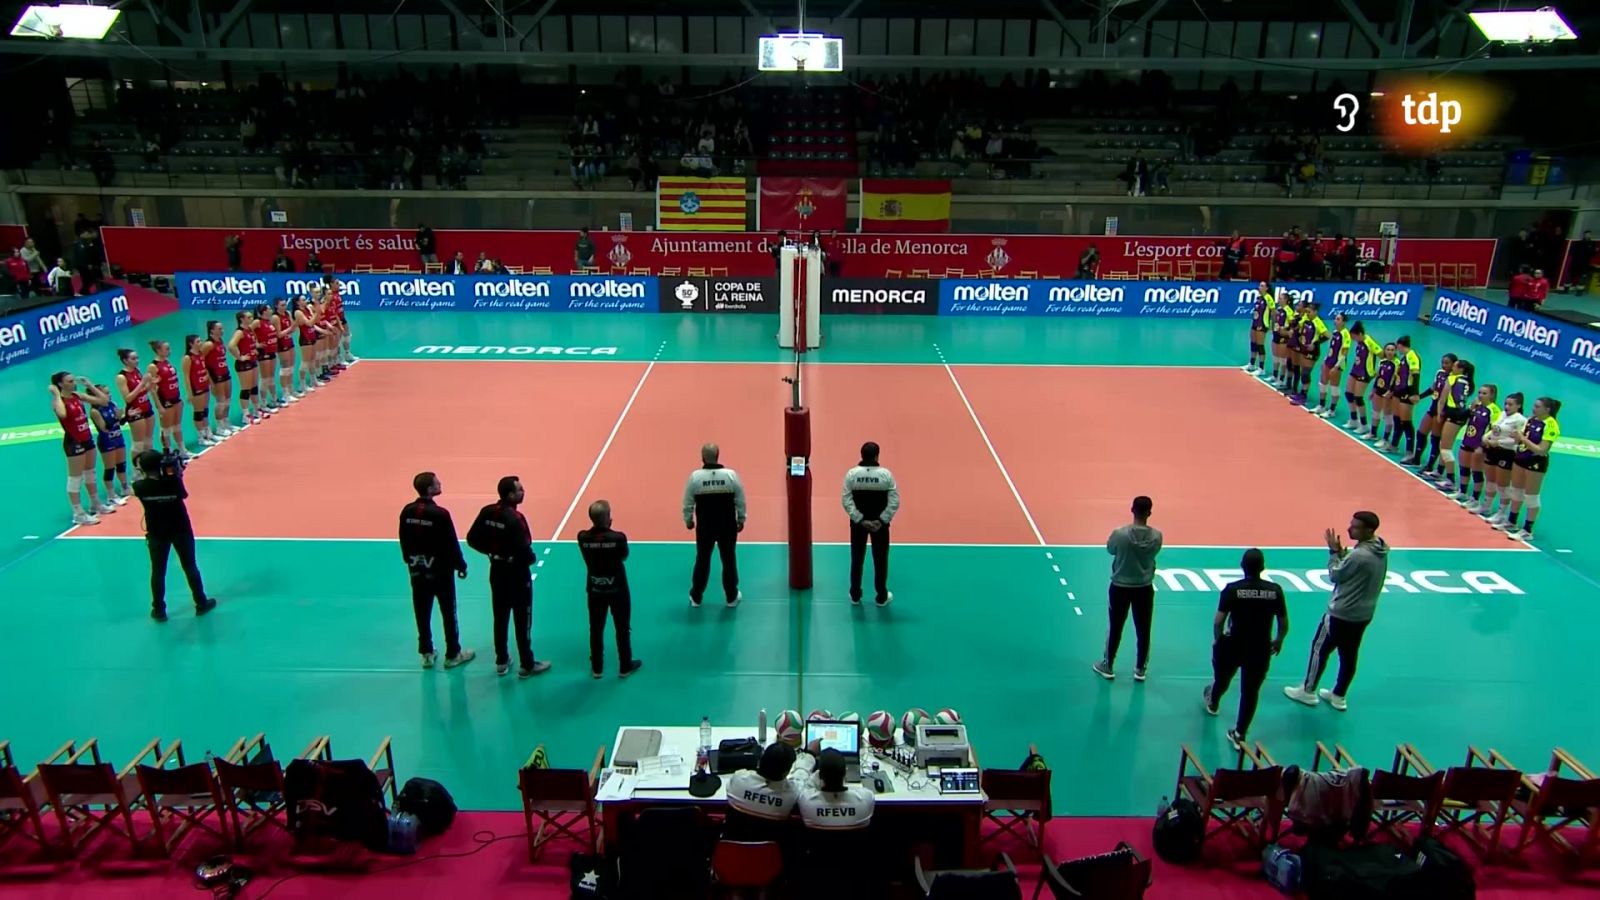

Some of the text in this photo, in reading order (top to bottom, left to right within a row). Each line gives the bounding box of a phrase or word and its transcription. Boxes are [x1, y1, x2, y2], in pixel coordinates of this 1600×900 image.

[281, 234, 349, 253] L'esport
[356, 234, 373, 250] és
[651, 238, 752, 256] Ajuntament
[871, 239, 890, 254] de
[894, 240, 968, 254] Menorca
[1124, 241, 1192, 260] L'esport
[191, 277, 266, 294] molten
[380, 279, 454, 296] molten
[474, 280, 549, 296] molten
[570, 280, 645, 297] molten
[715, 283, 760, 291] COPA DE
[954, 284, 1028, 300] molten
[1049, 284, 1124, 302] molten
[715, 293, 764, 301] LA REINA
[832, 290, 926, 303] MENORCA
[1144, 286, 1218, 303] molten
[1333, 288, 1408, 305] molten
[40, 302, 102, 335] molten
[1436, 296, 1487, 325] molten
[1498, 315, 1559, 348] molten
[412, 346, 618, 355] MENORCA
[856, 476, 880, 484] RFEVB
[744, 790, 783, 807] RFEVB
[816, 808, 856, 817] RFEVB
